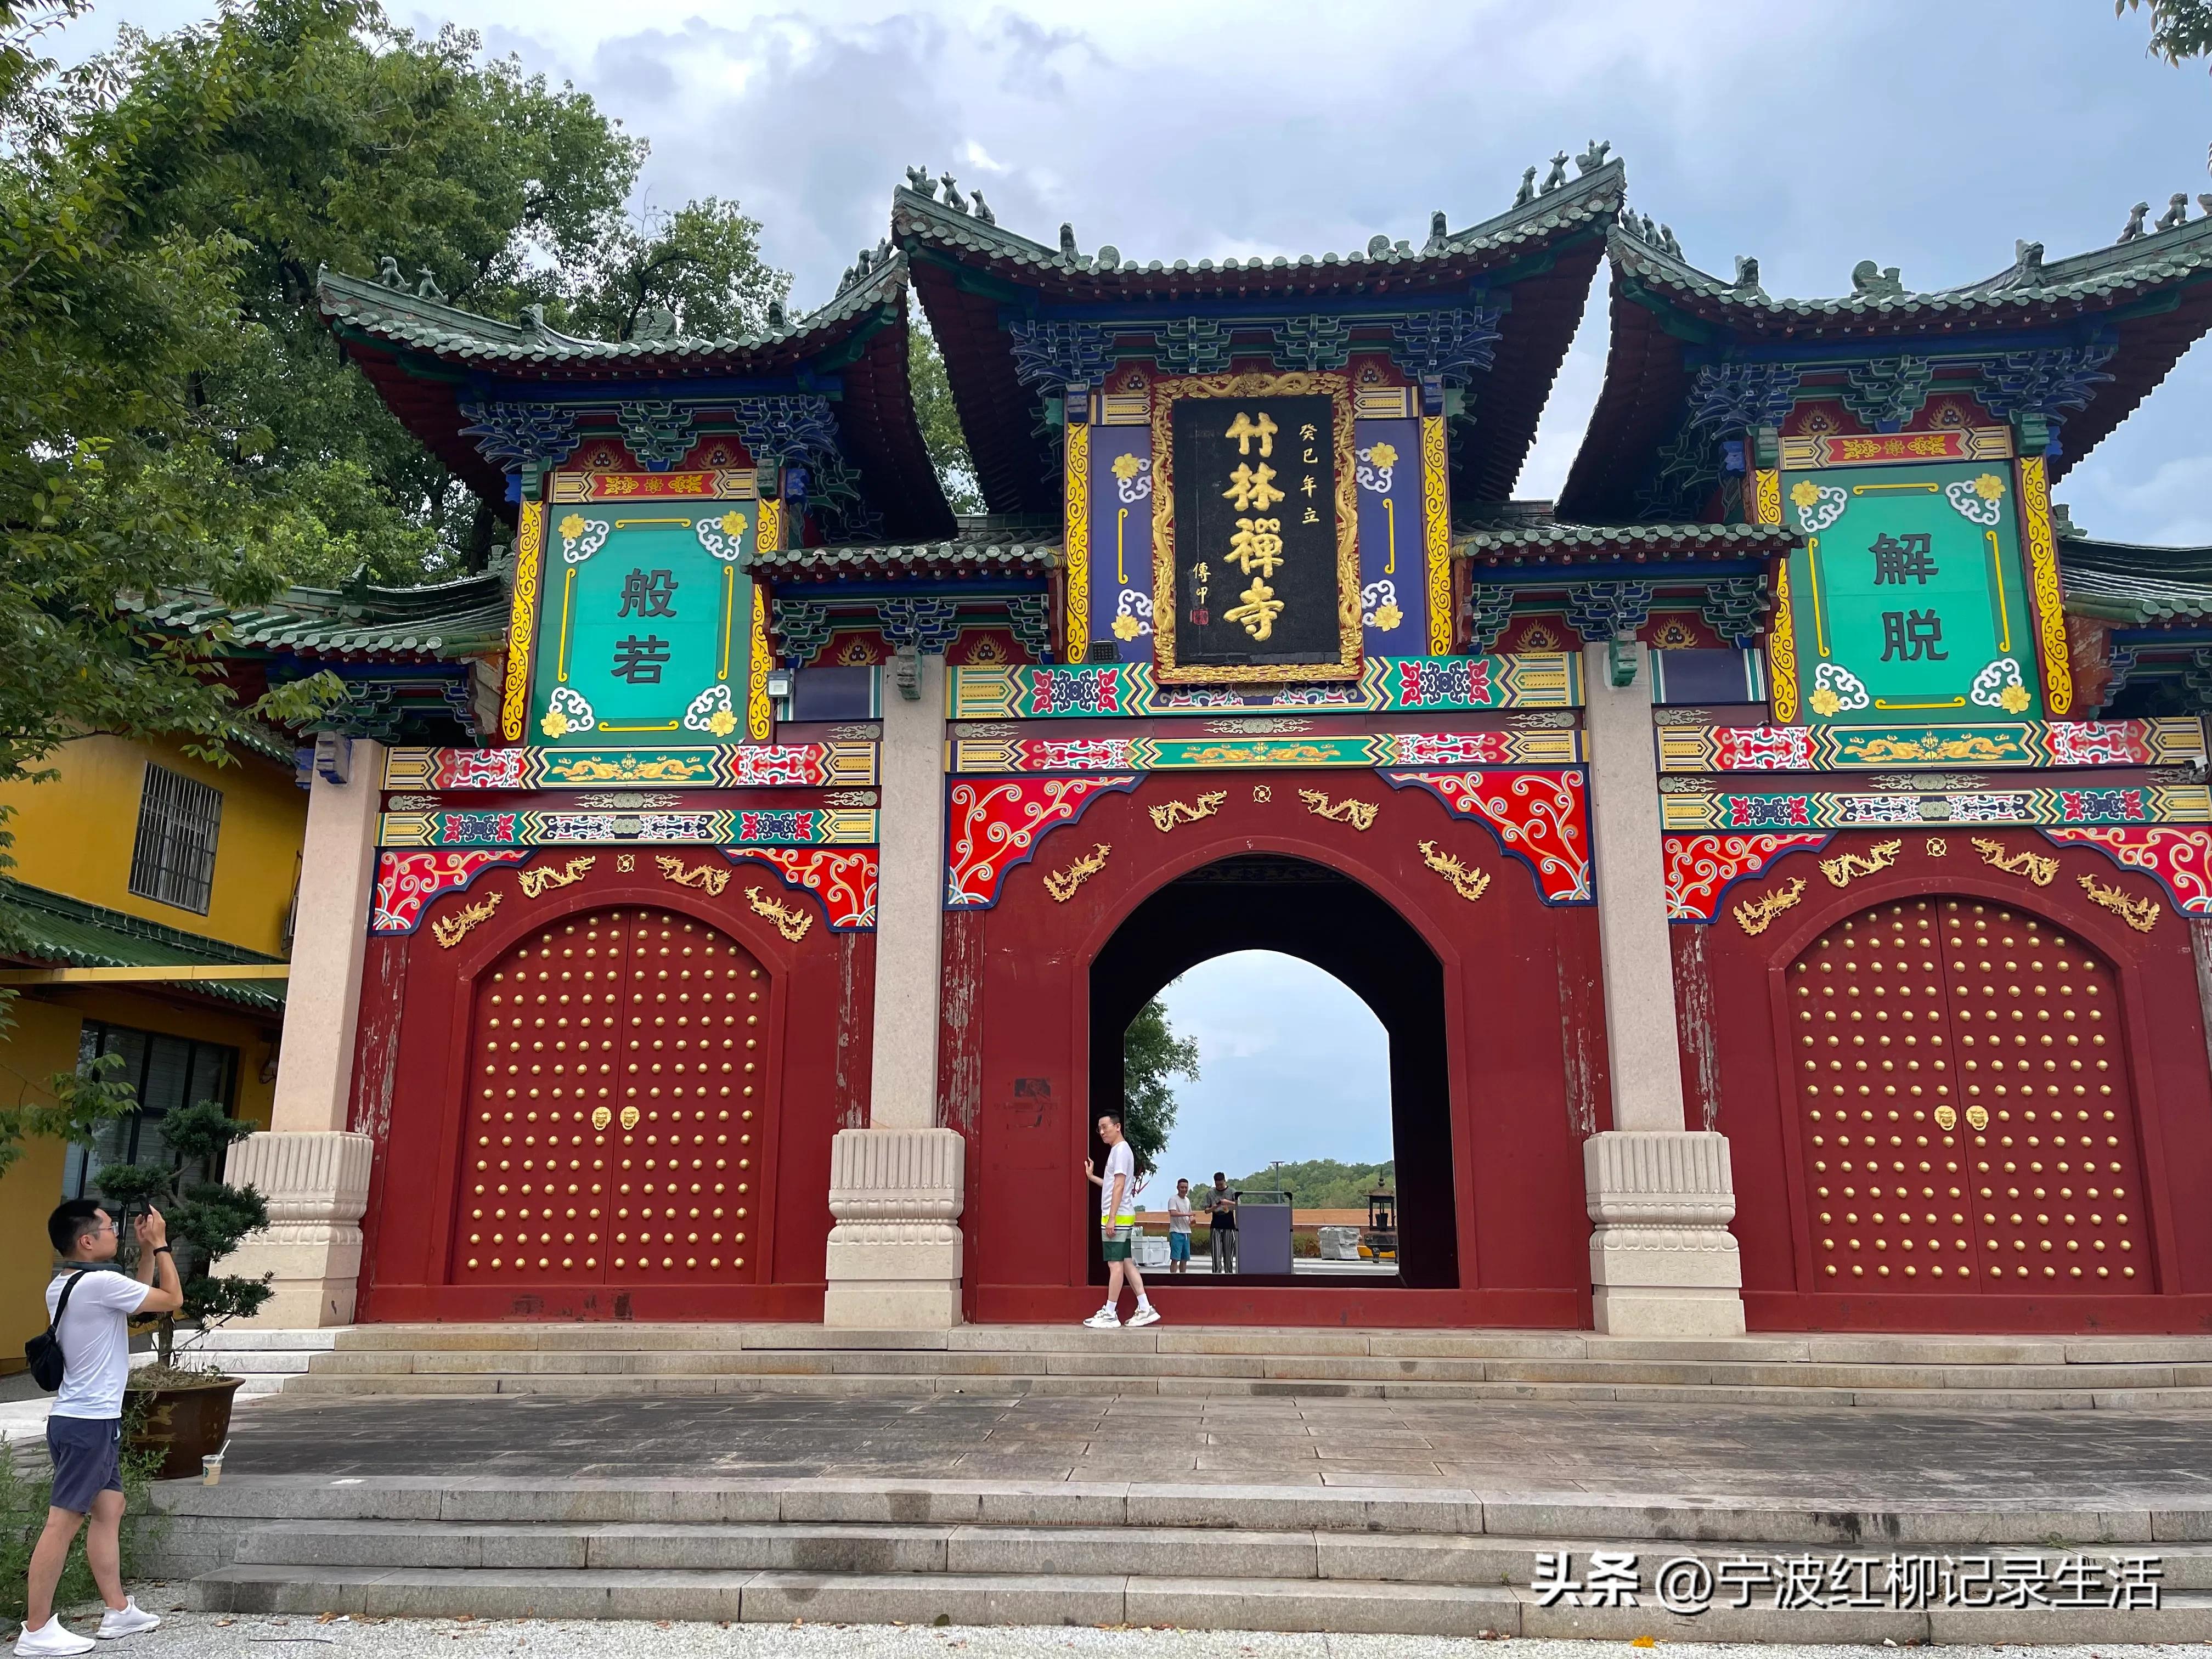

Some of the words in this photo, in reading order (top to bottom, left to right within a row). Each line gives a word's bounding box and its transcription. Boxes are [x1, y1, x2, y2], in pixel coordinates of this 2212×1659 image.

[1222, 411, 1285, 641] 竹林禪寺
[611, 568, 679, 684] 般若
[1868, 532, 1949, 662] 解脱
